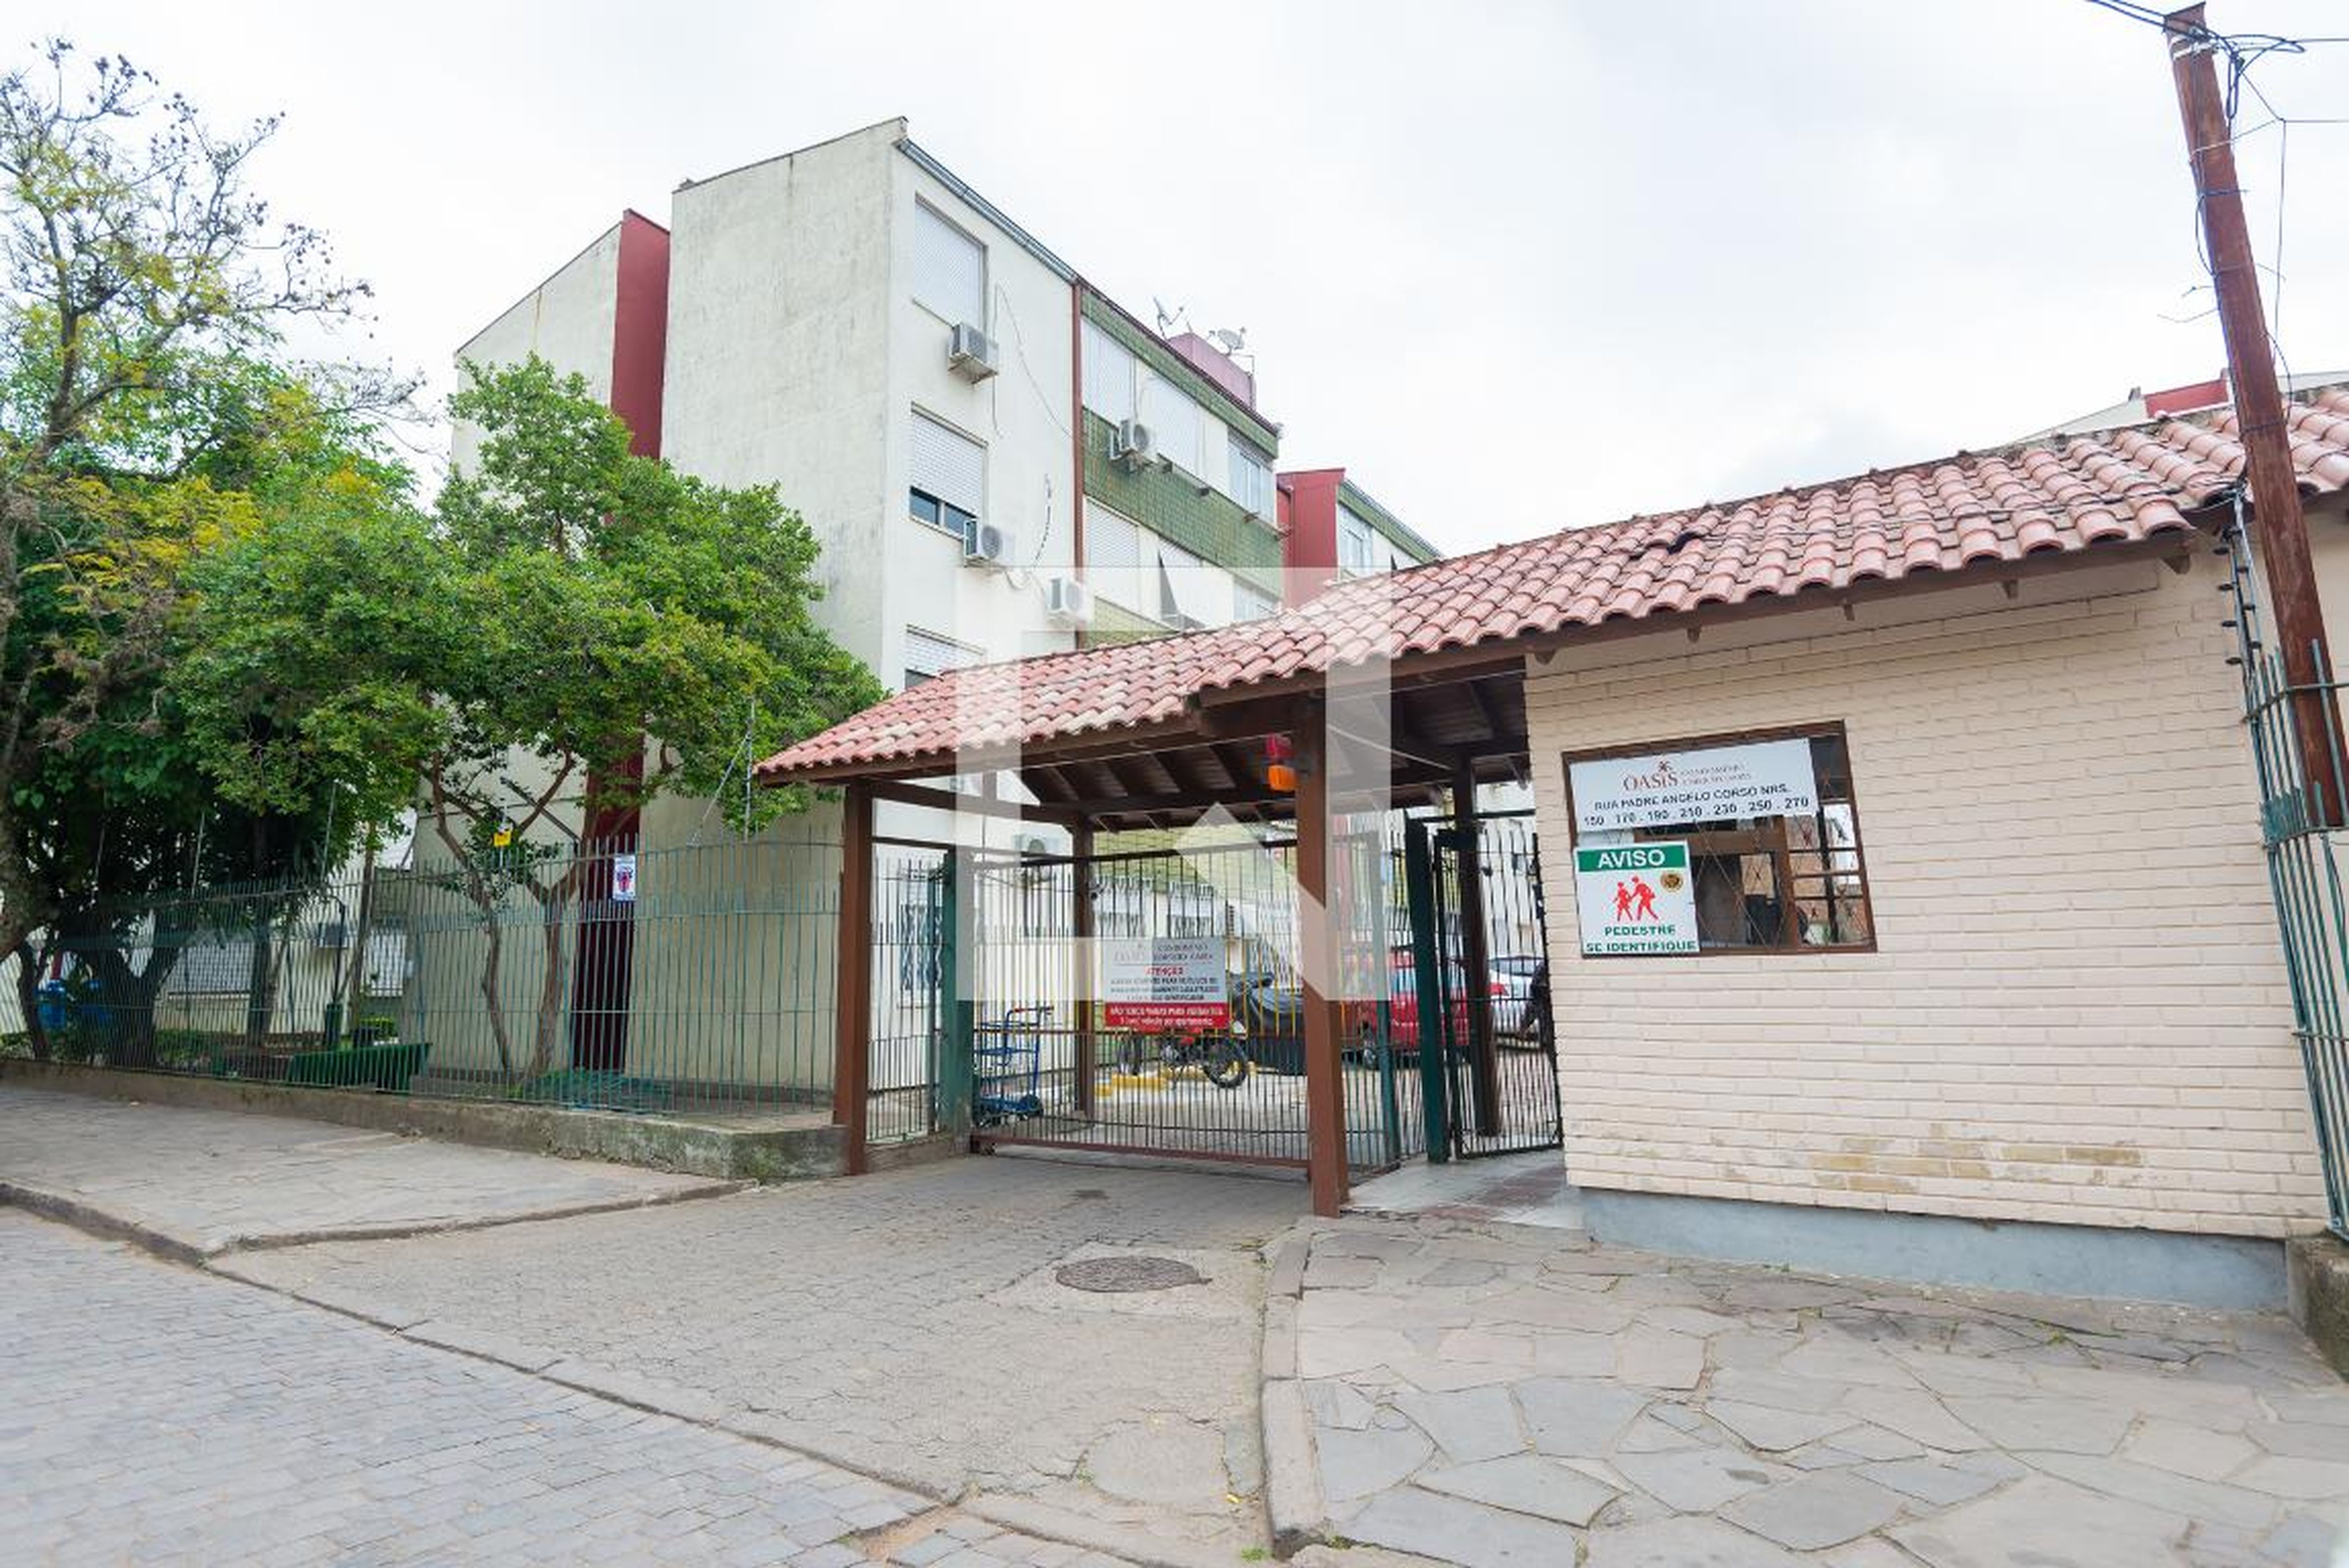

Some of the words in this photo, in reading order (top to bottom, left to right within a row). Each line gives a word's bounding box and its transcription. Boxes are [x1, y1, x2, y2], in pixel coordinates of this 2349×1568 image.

[1623, 772, 1678, 791] OASIS
[1595, 799, 1619, 811] RUA
[1621, 796, 1660, 808] PADRE
[1662, 791, 1710, 804] ANGELO
[1713, 786, 1757, 799] CORSO
[1680, 806, 1702, 818] 210
[1713, 803, 1737, 815] 230
[1748, 800, 1772, 812] 250
[1784, 797, 1809, 809] 270
[1597, 849, 1665, 869] AVISO
[1605, 924, 1676, 936] PEDESTRE
[1586, 942, 1602, 952] SE
[1606, 940, 1696, 952] IDENTIFIQUE
